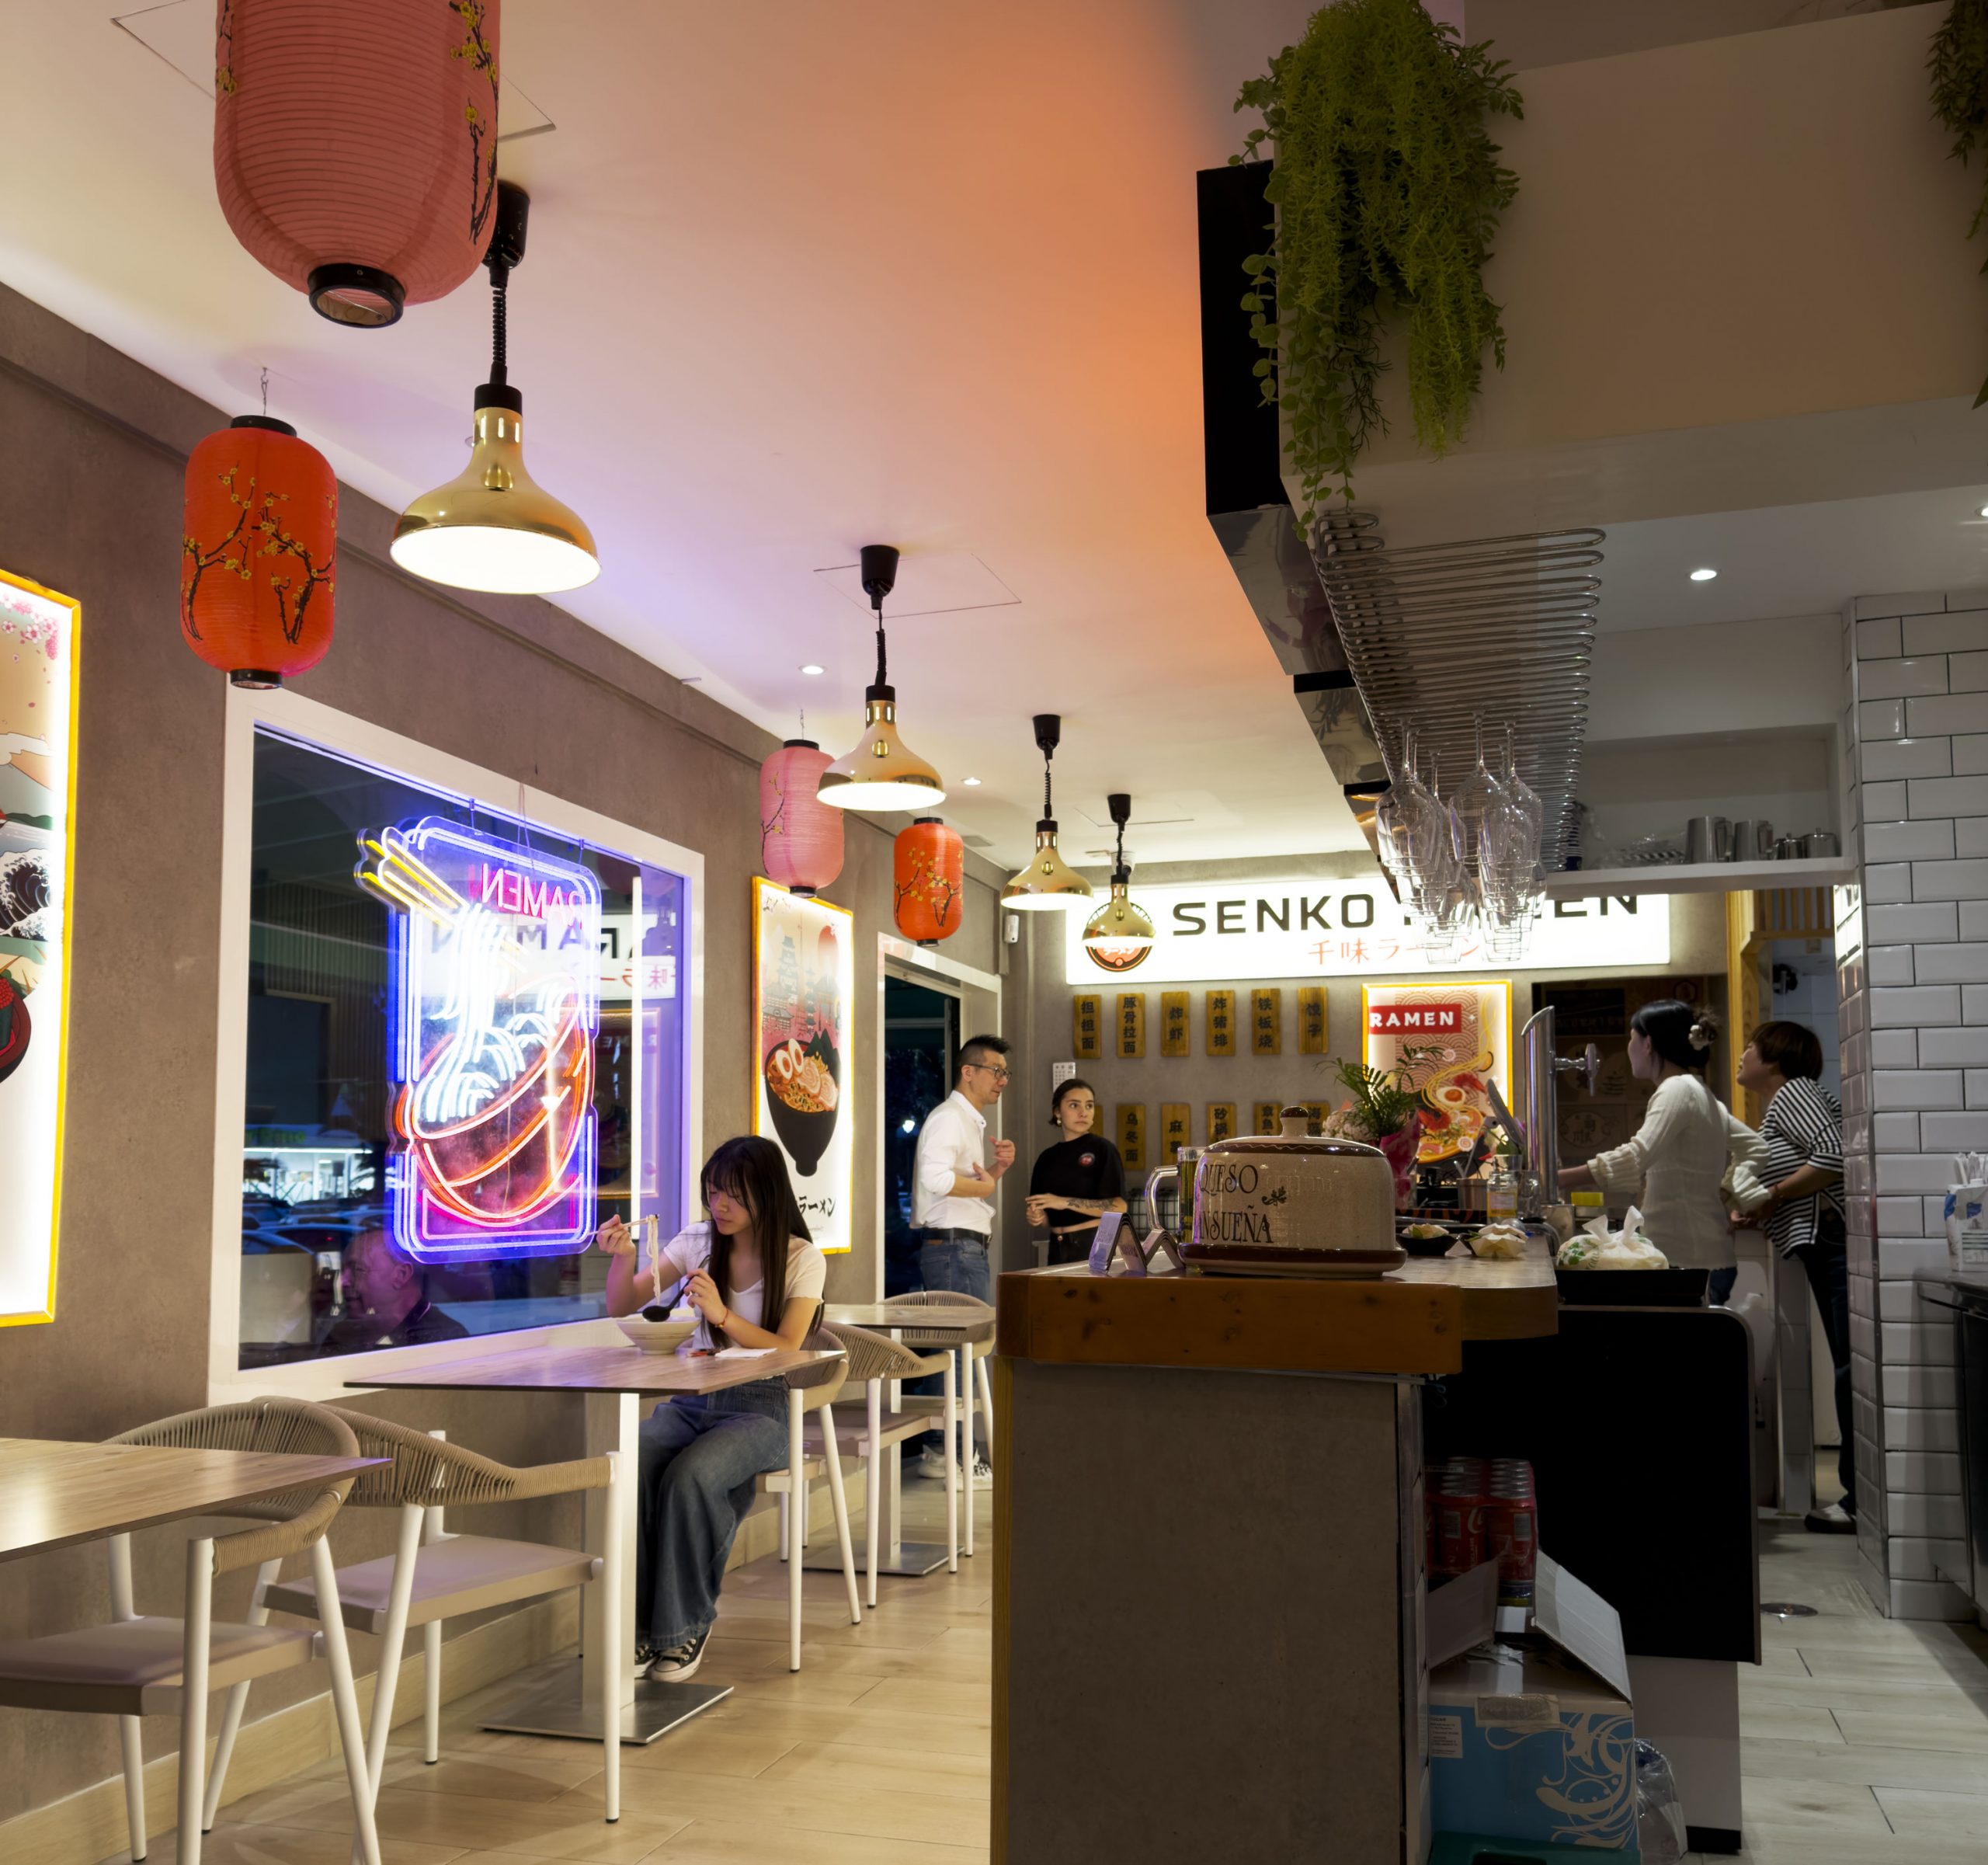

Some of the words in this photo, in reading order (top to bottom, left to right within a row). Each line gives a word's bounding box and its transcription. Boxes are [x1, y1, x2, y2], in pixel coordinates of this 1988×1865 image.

[1172, 892, 1375, 937] SENKO
[1080, 1001, 1095, 1050] 担担面
[1123, 997, 1137, 1054] 豚骨拉面
[1169, 1007, 1183, 1041] 炸虾
[1212, 997, 1229, 1047] 炸猪排
[1257, 997, 1274, 1048] 铁板烧
[1369, 1011, 1455, 1028] RAMEN
[1124, 1112, 1139, 1162] 乌冬面
[1198, 1163, 1259, 1196] QUESO
